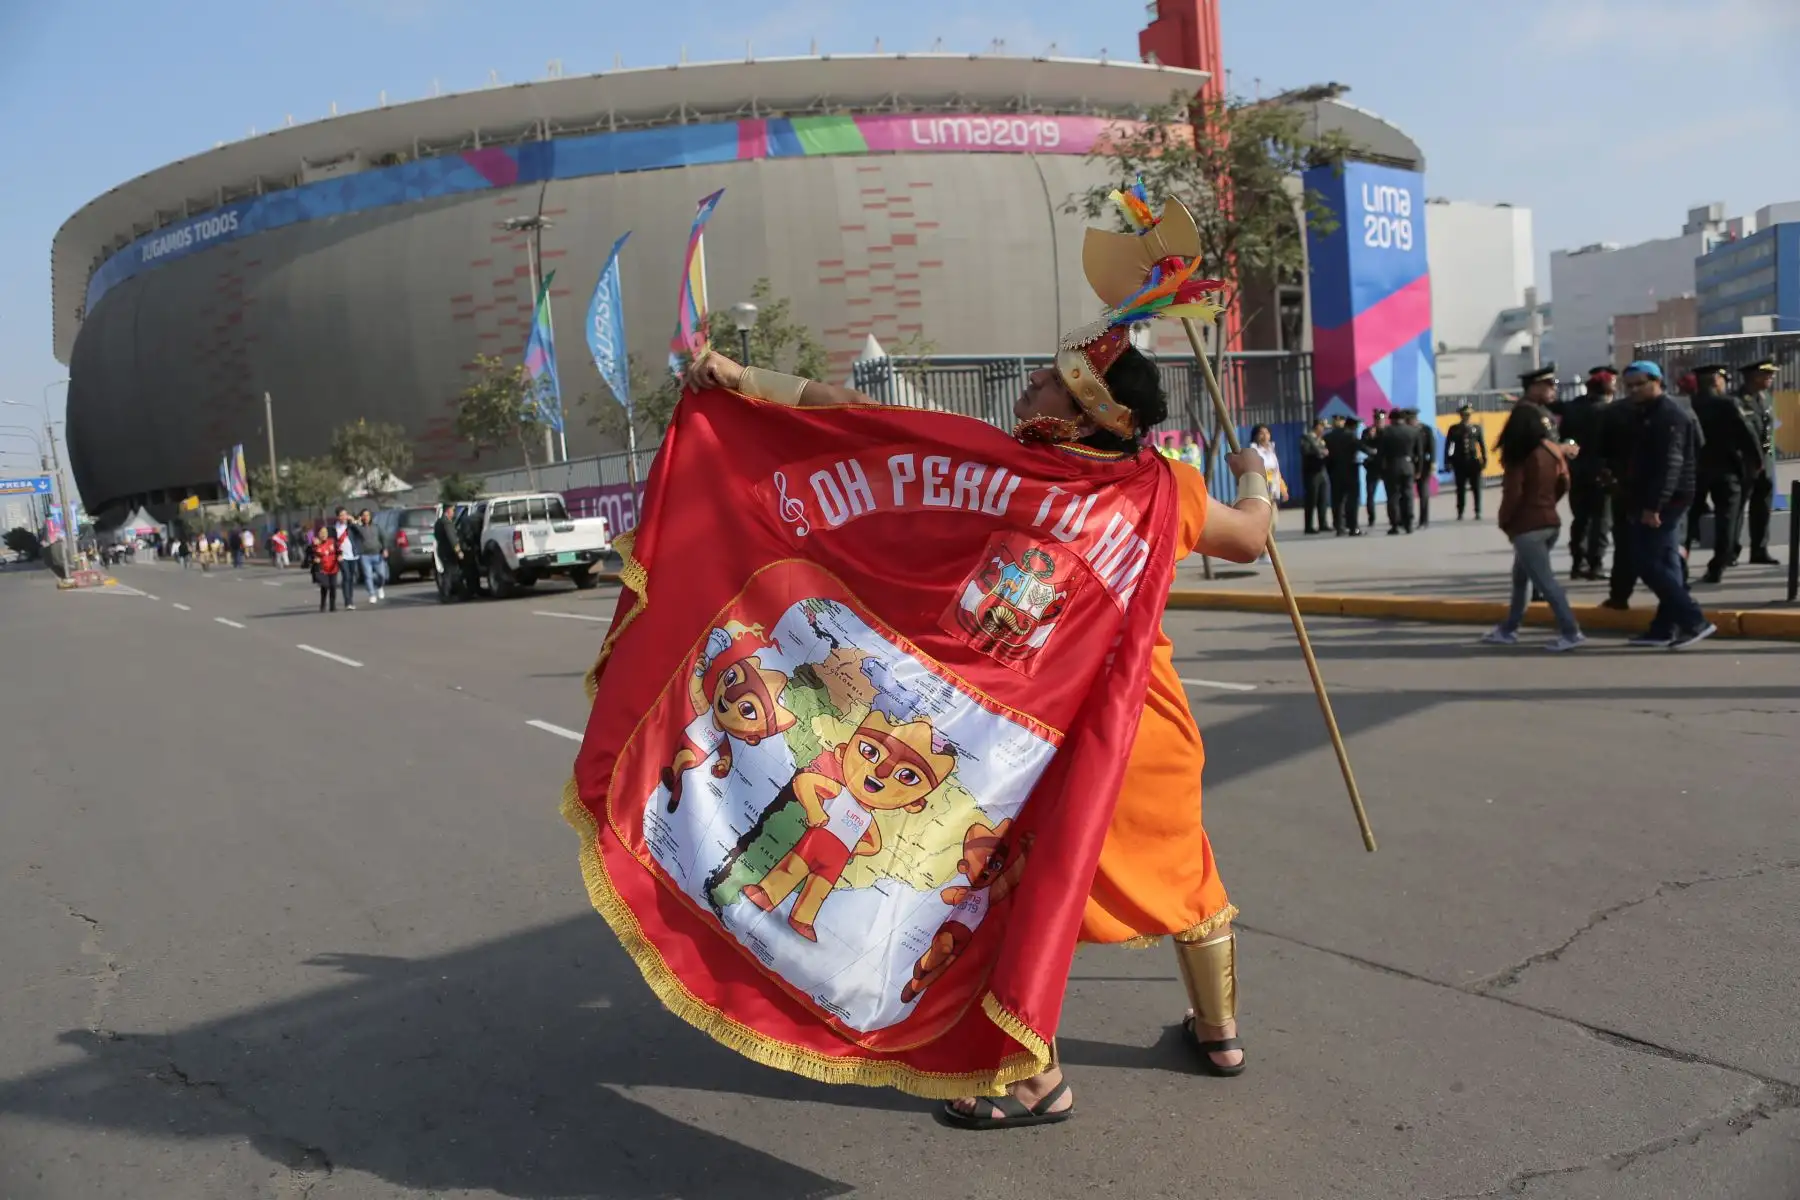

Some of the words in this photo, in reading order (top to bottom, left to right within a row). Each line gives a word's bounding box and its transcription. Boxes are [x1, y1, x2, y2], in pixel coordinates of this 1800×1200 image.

[1361, 182, 1412, 217] Lima
[142, 226, 193, 262] JUGAMOS
[193, 210, 238, 242] TODOS
[1364, 214, 1413, 252] 2019
[809, 458, 877, 527] OH
[887, 453, 1022, 517] PERU
[1031, 485, 1099, 543] TU
[830, 668, 863, 696] COLOMBIA
